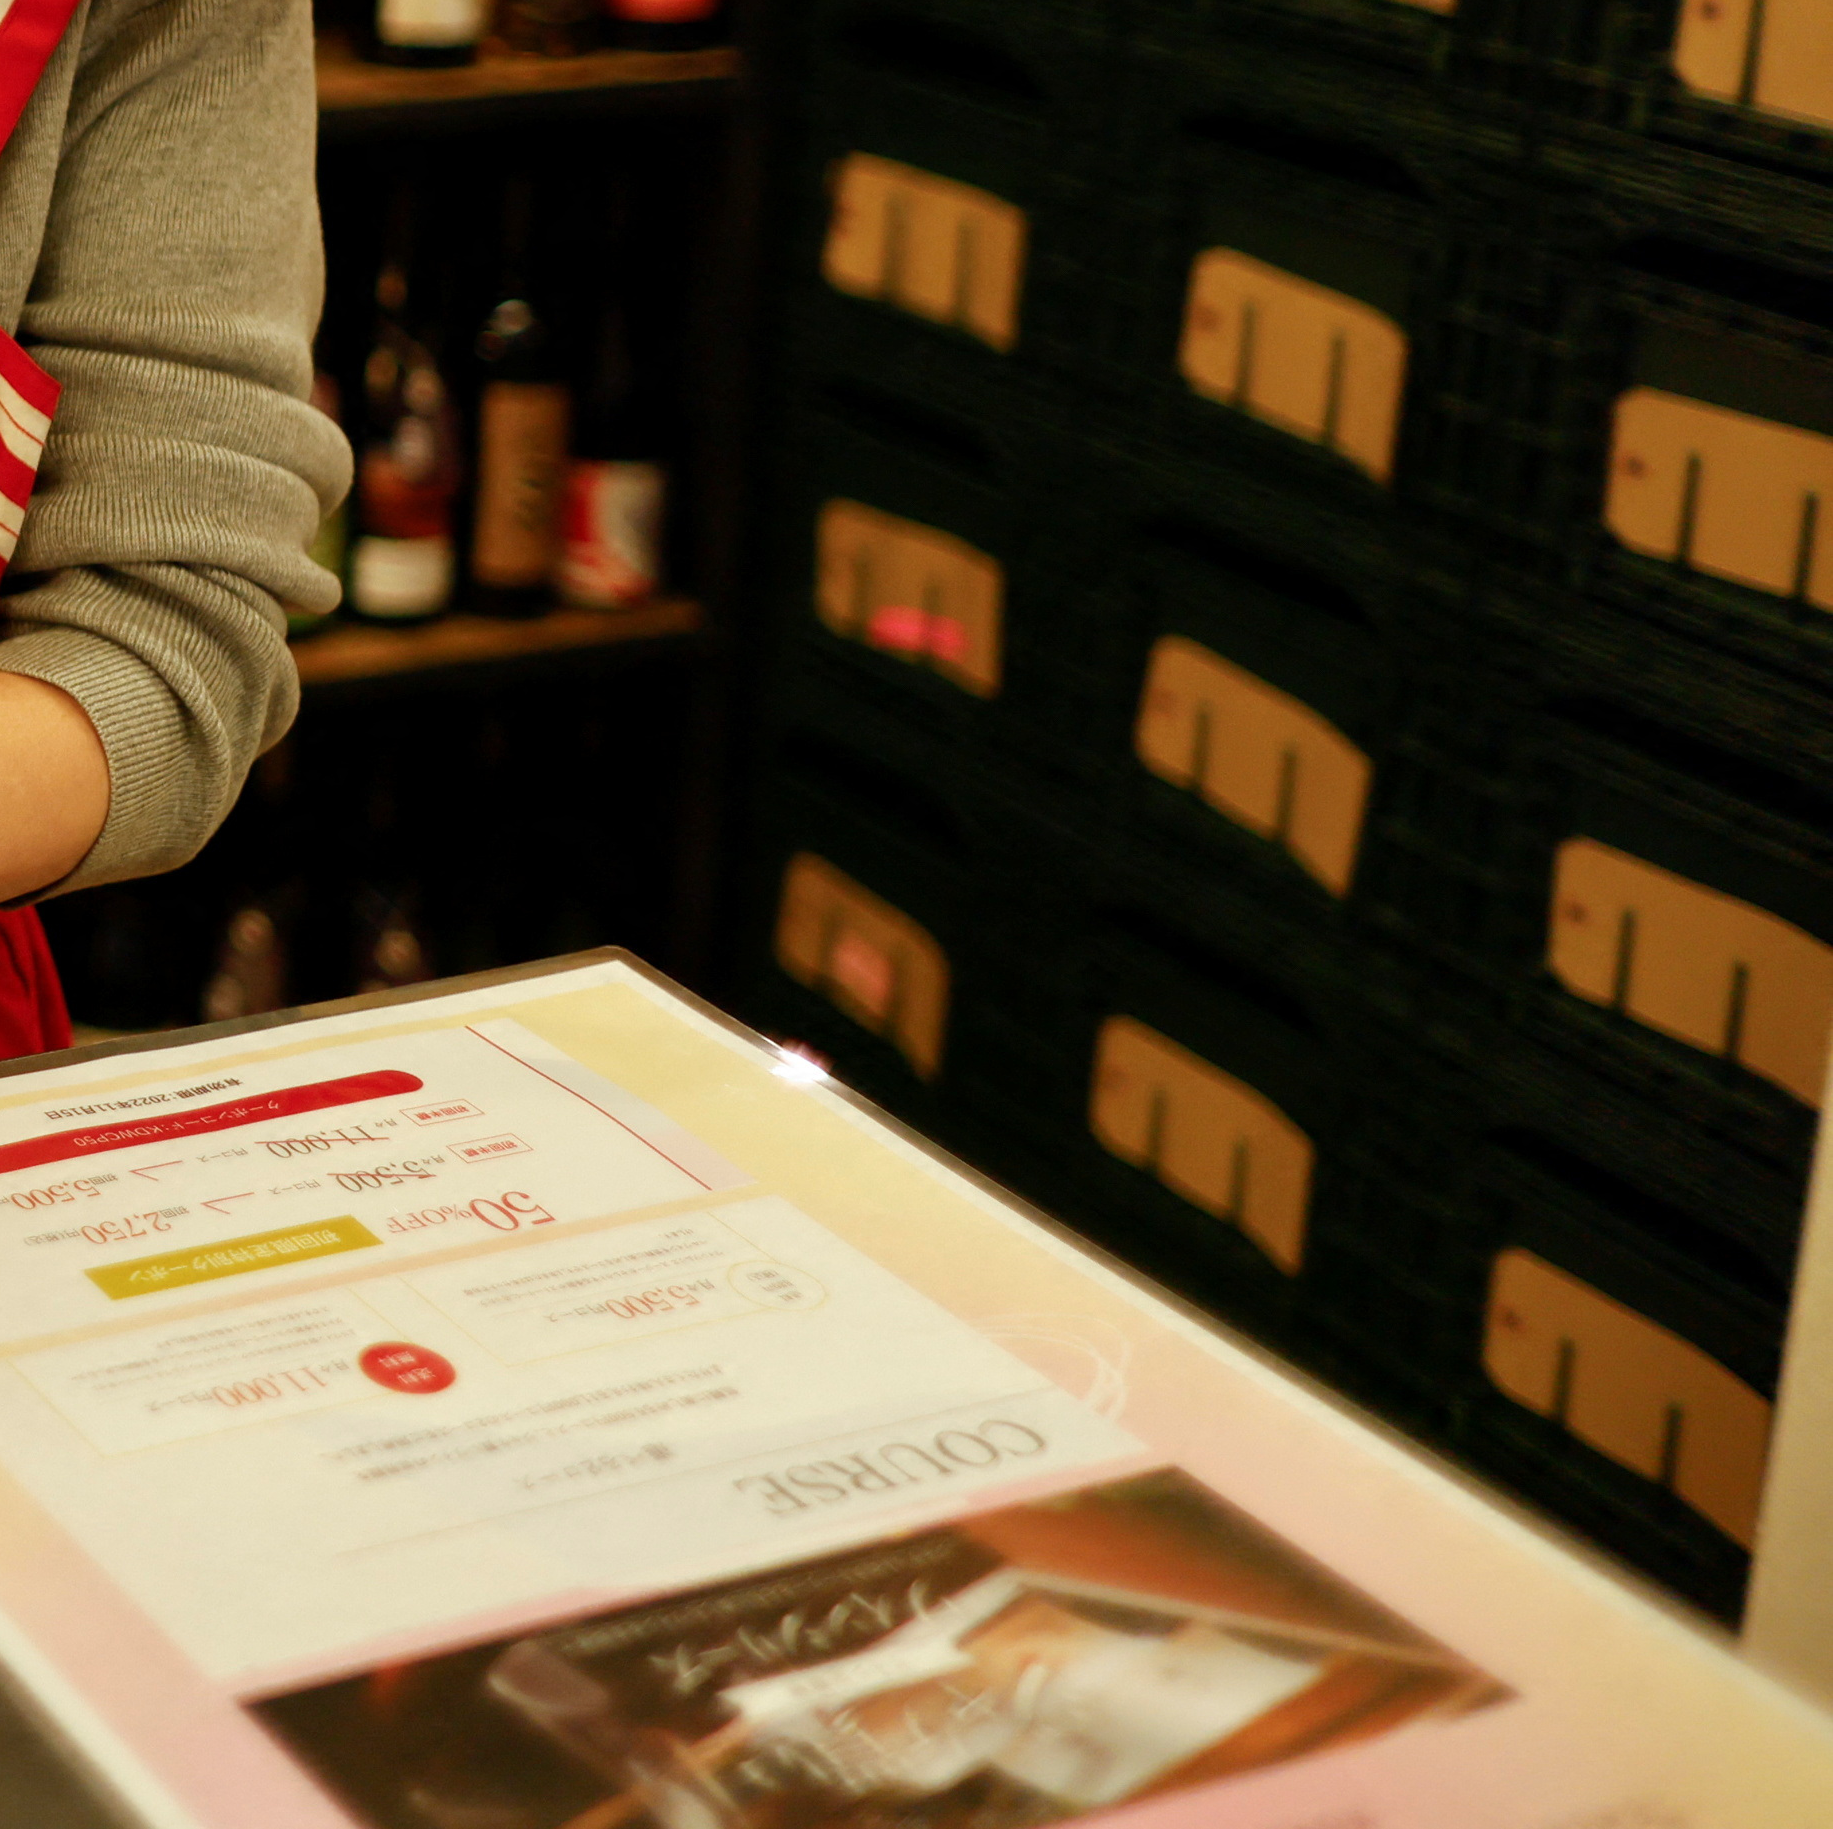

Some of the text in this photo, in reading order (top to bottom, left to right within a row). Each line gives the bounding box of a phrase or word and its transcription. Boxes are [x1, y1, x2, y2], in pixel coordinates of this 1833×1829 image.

[385, 1190, 556, 1234] 50%OFF
[128, 1228, 343, 1283] 初回限定特別クーポン
[732, 1419, 1047, 1519] COURSE
